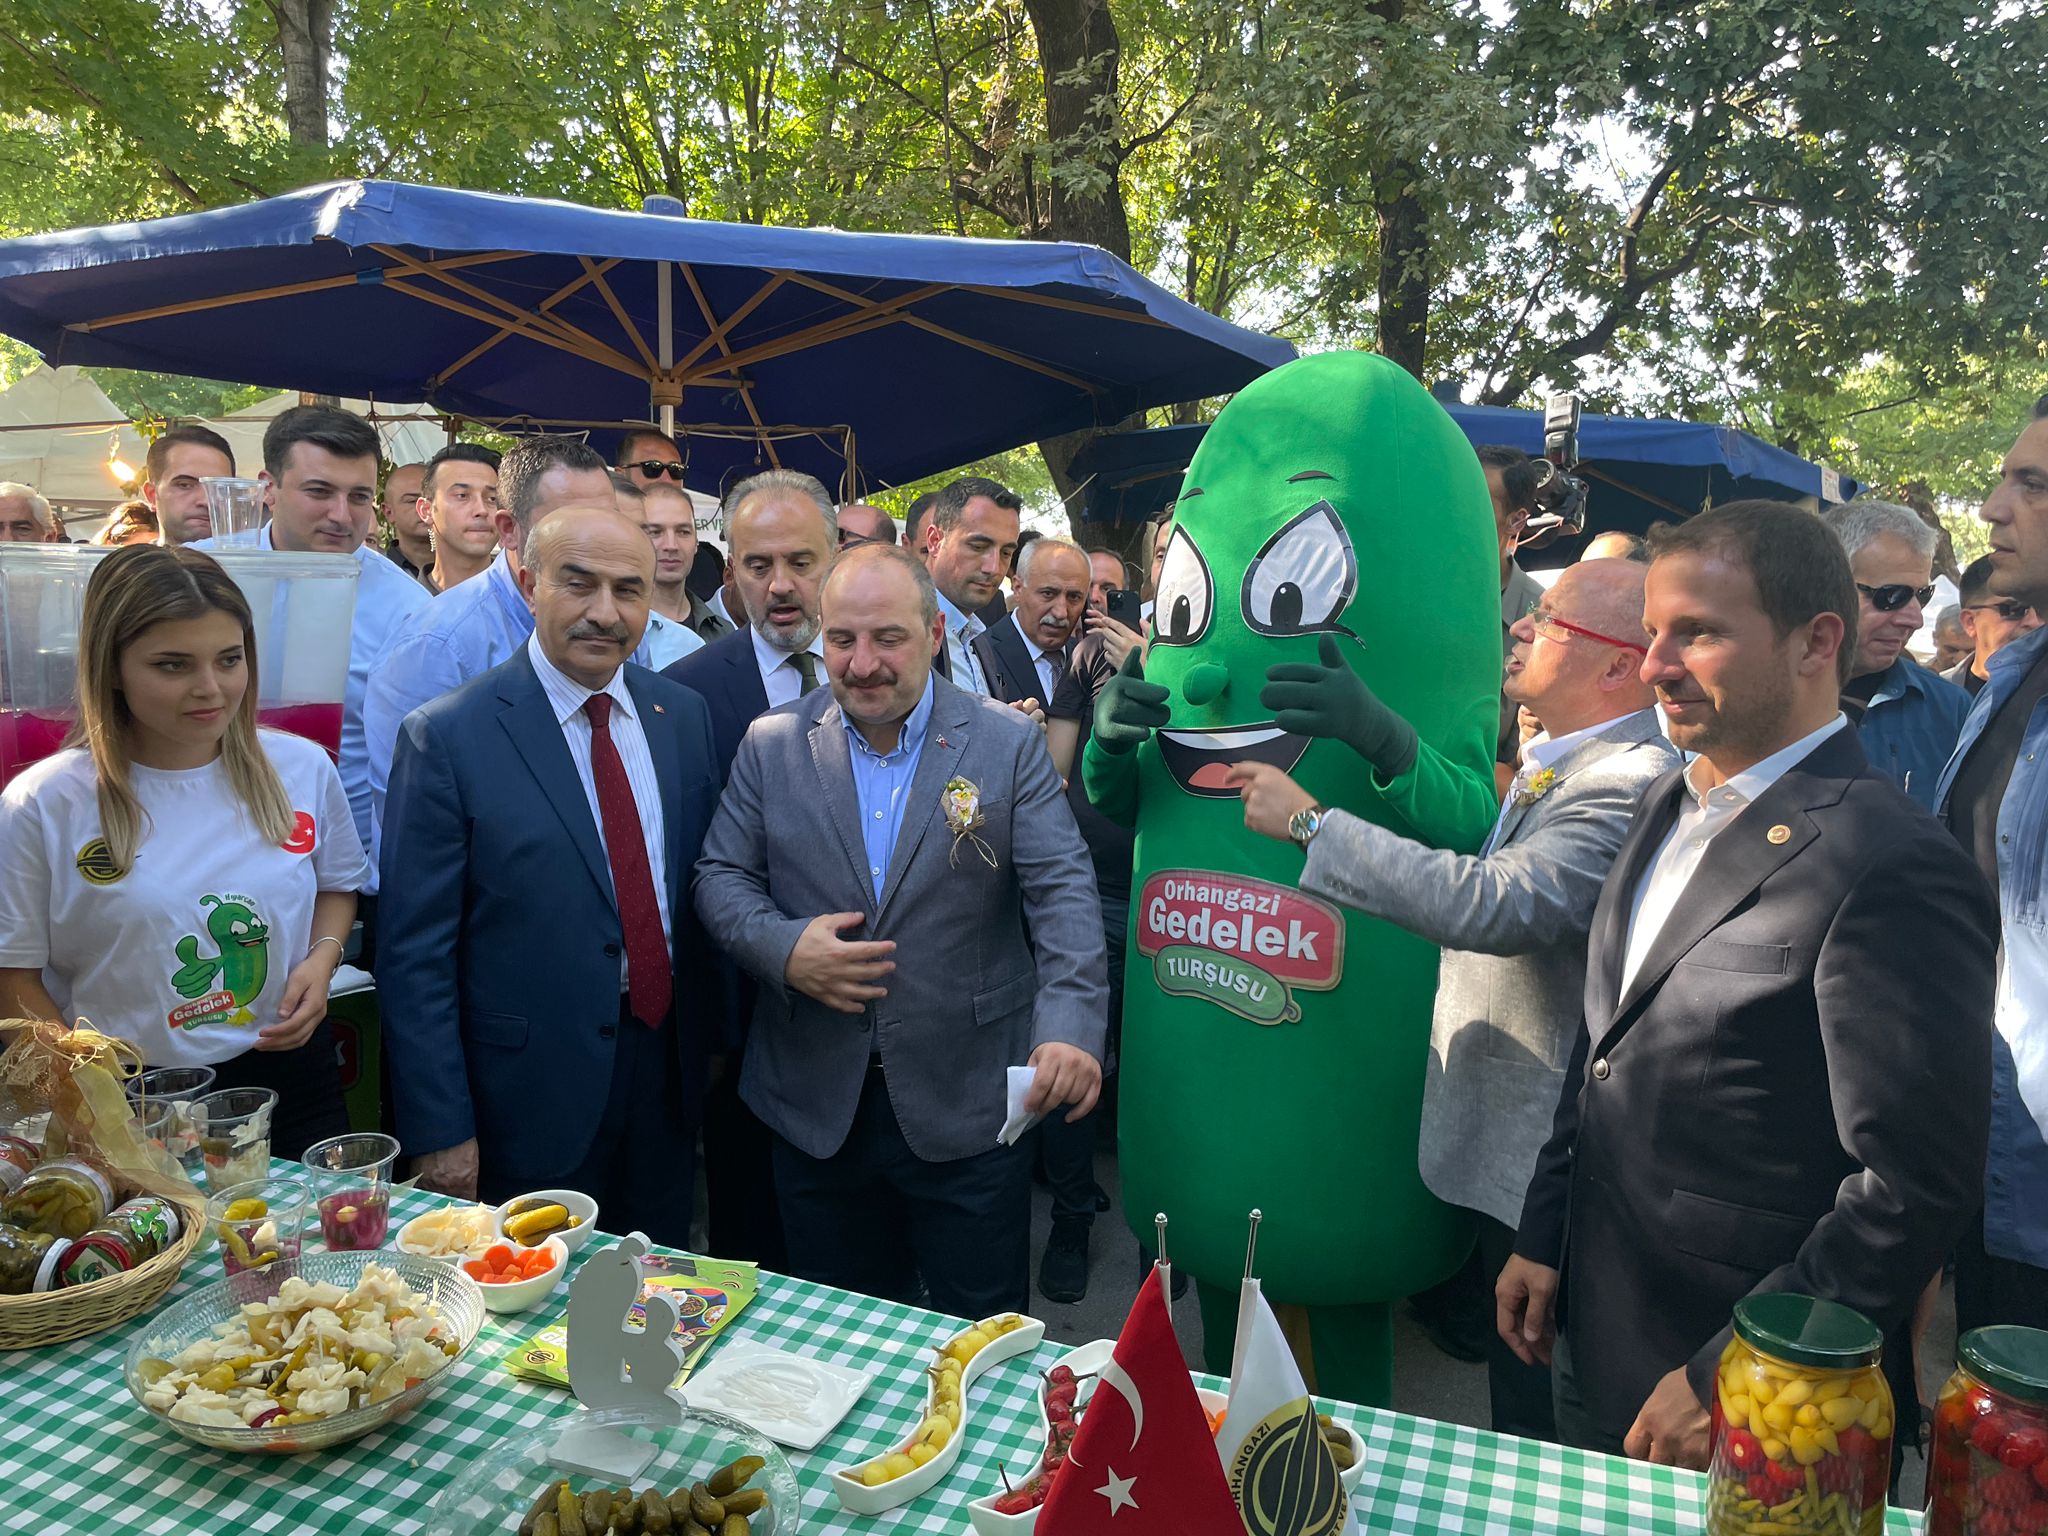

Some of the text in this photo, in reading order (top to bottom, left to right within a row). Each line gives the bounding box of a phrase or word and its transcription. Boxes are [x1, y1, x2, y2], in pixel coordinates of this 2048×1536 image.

[1164, 880, 1281, 916] Orhangazi
[1148, 896, 1320, 961] Gedelek
[1167, 957, 1268, 1002] TURŞUSU
[173, 995, 231, 1021] Gedelek
